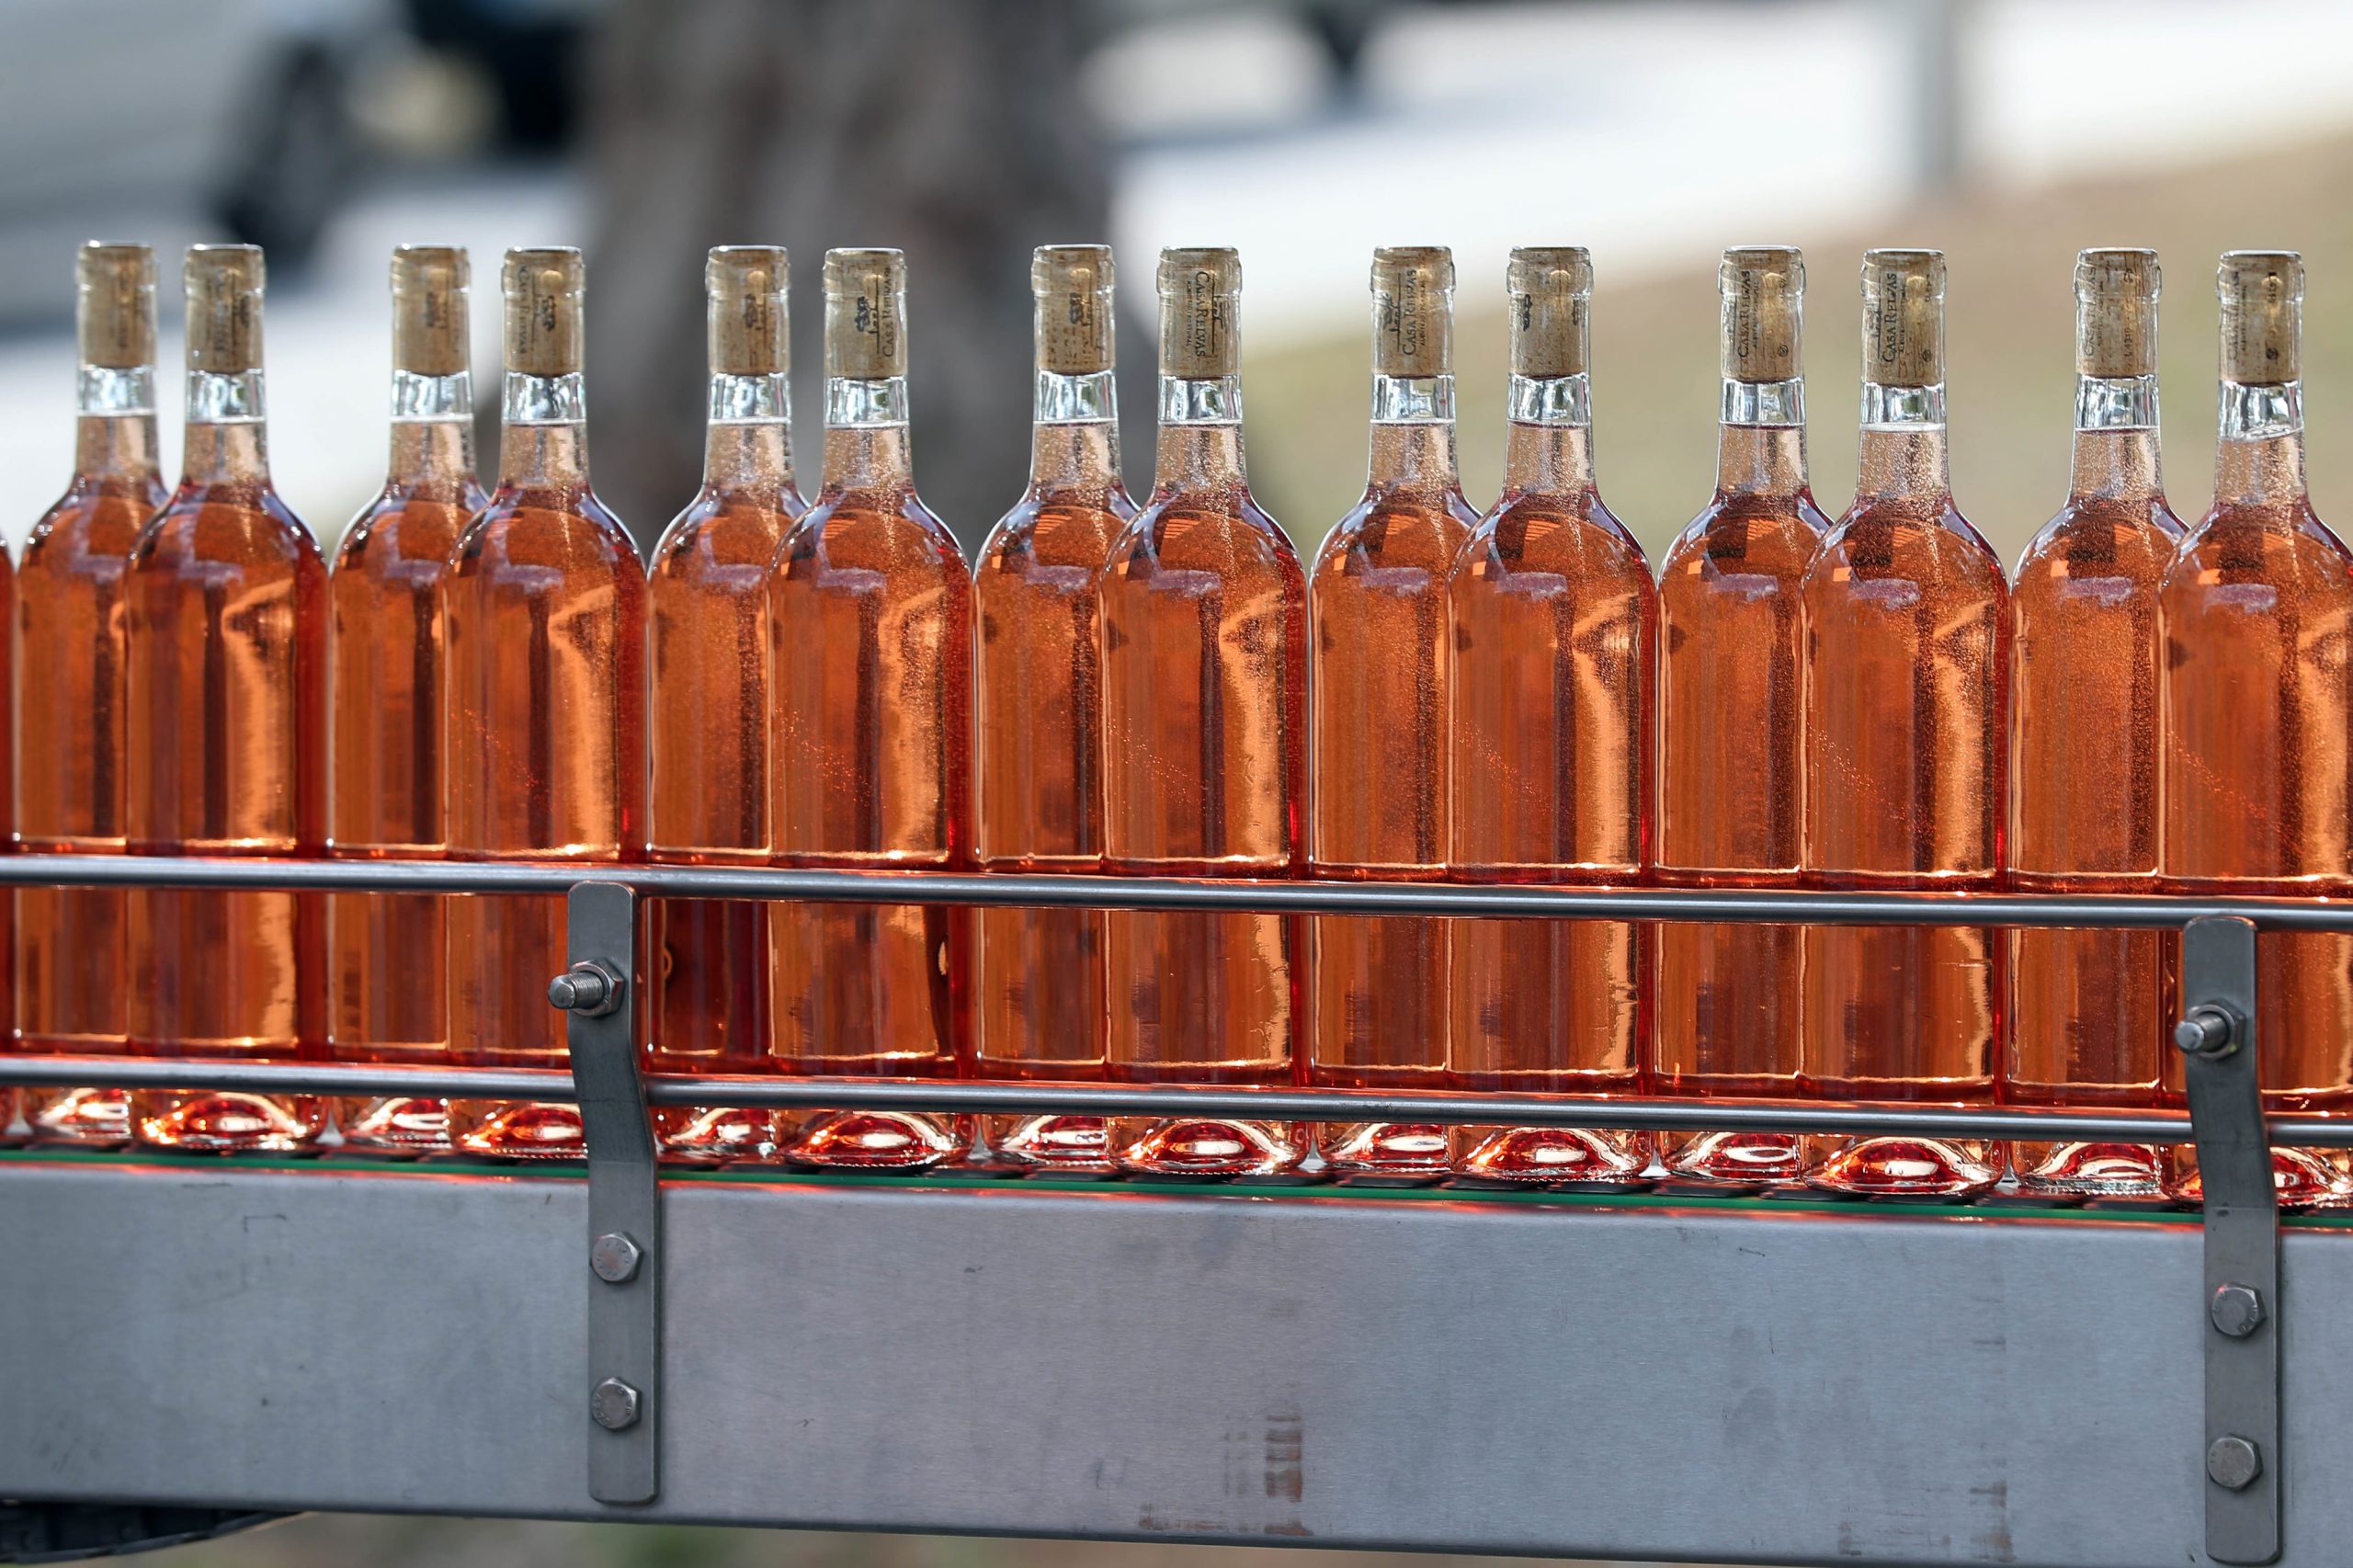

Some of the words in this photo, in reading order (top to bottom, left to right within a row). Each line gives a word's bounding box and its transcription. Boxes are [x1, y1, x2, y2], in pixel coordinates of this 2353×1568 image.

[1195, 271, 1210, 306] CASA
[882, 322, 894, 358] CASA
[1195, 309, 1209, 358] RELVAS
[1402, 321, 1417, 356] CASA
[1737, 322, 1750, 358] CASA
[1881, 325, 1897, 363] CASA
